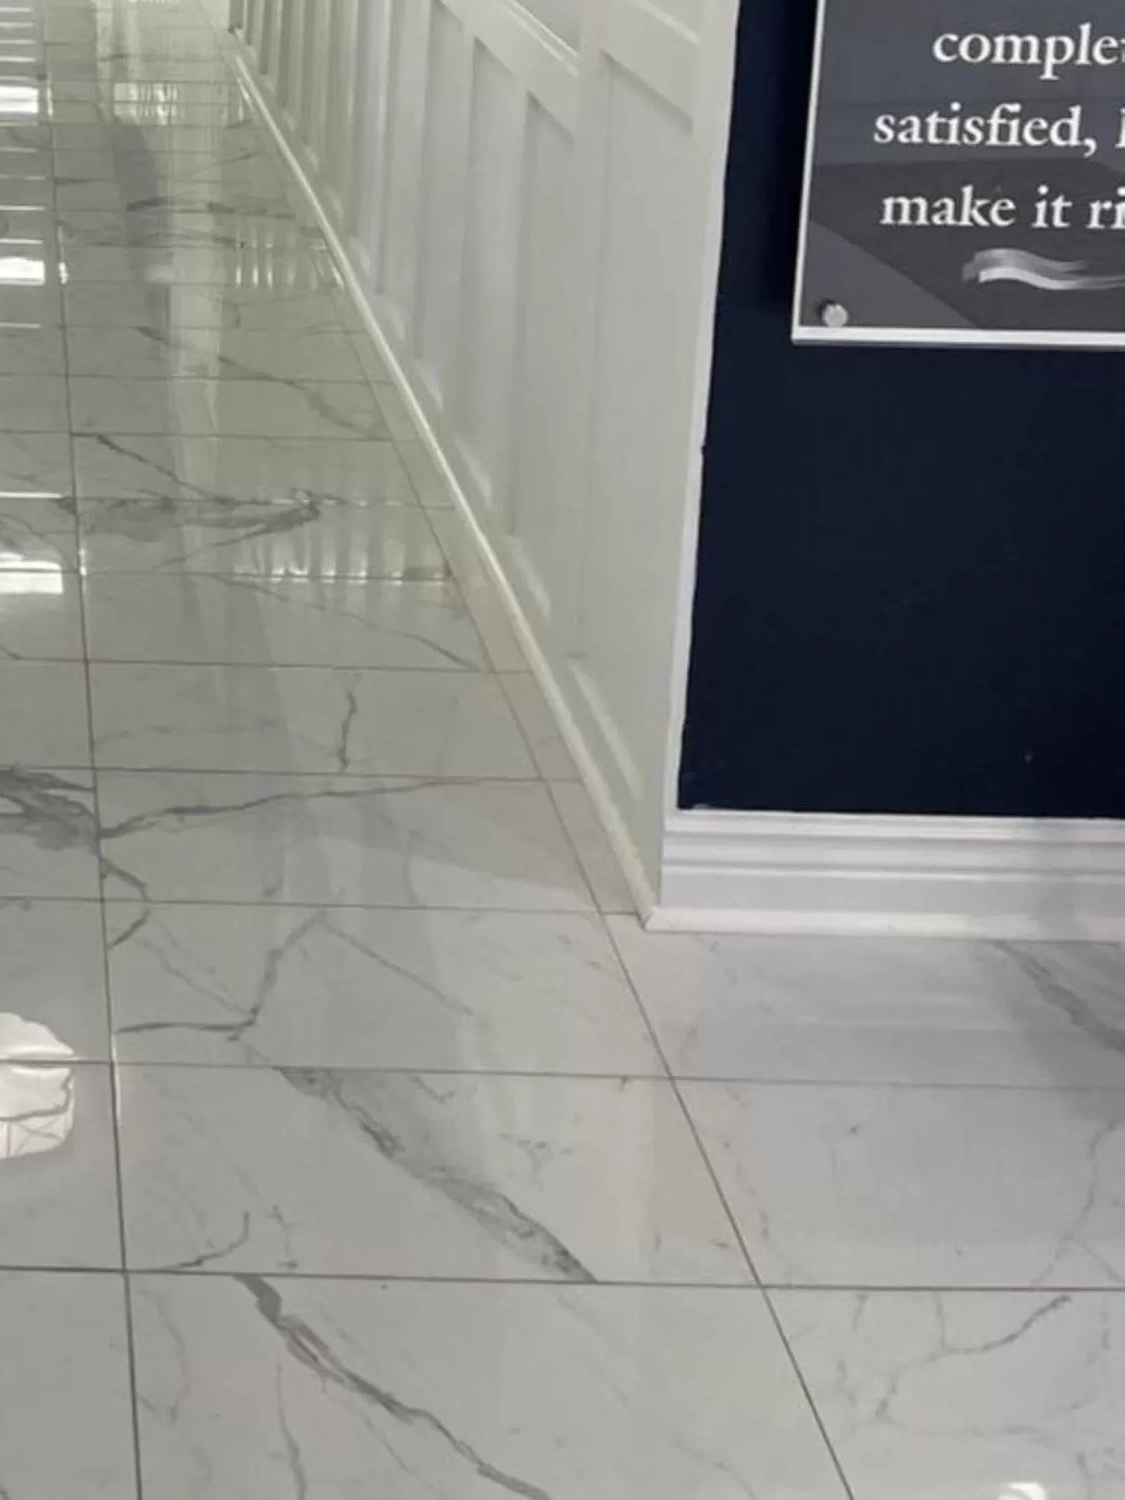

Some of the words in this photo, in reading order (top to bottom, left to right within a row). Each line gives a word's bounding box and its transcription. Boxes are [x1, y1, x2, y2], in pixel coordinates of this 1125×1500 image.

[932, 21, 1125, 80] comple
[874, 101, 1097, 157] satisfied,
[879, 184, 1017, 227] make
[1031, 184, 1073, 228] it
